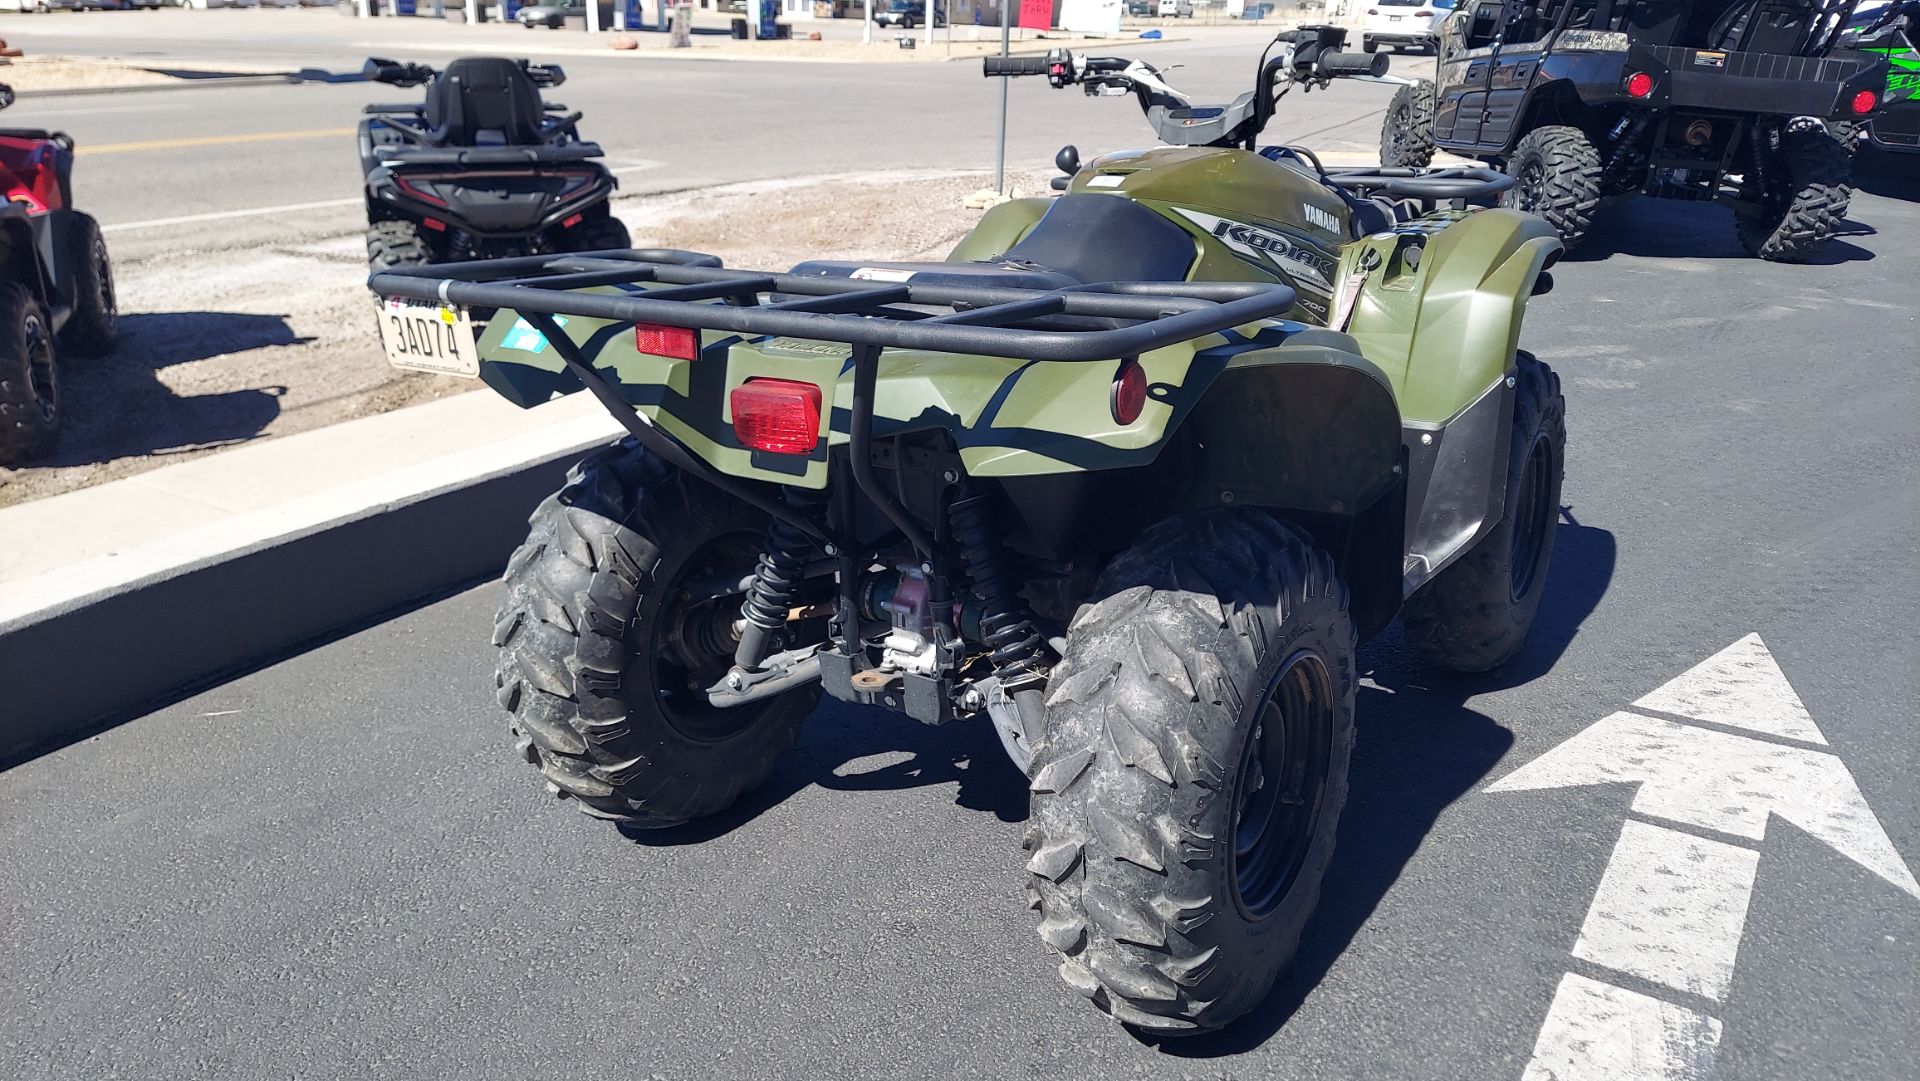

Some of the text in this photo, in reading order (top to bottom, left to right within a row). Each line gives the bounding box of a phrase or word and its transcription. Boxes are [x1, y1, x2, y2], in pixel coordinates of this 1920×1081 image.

[1022, 4, 1050, 15] THRU
[1303, 202, 1341, 235] YAMAHA
[1211, 219, 1334, 274] KODIAK
[1285, 266, 1329, 287] ULTRAMATIC
[1302, 298, 1326, 313] 700
[391, 315, 460, 361] 3AD74
